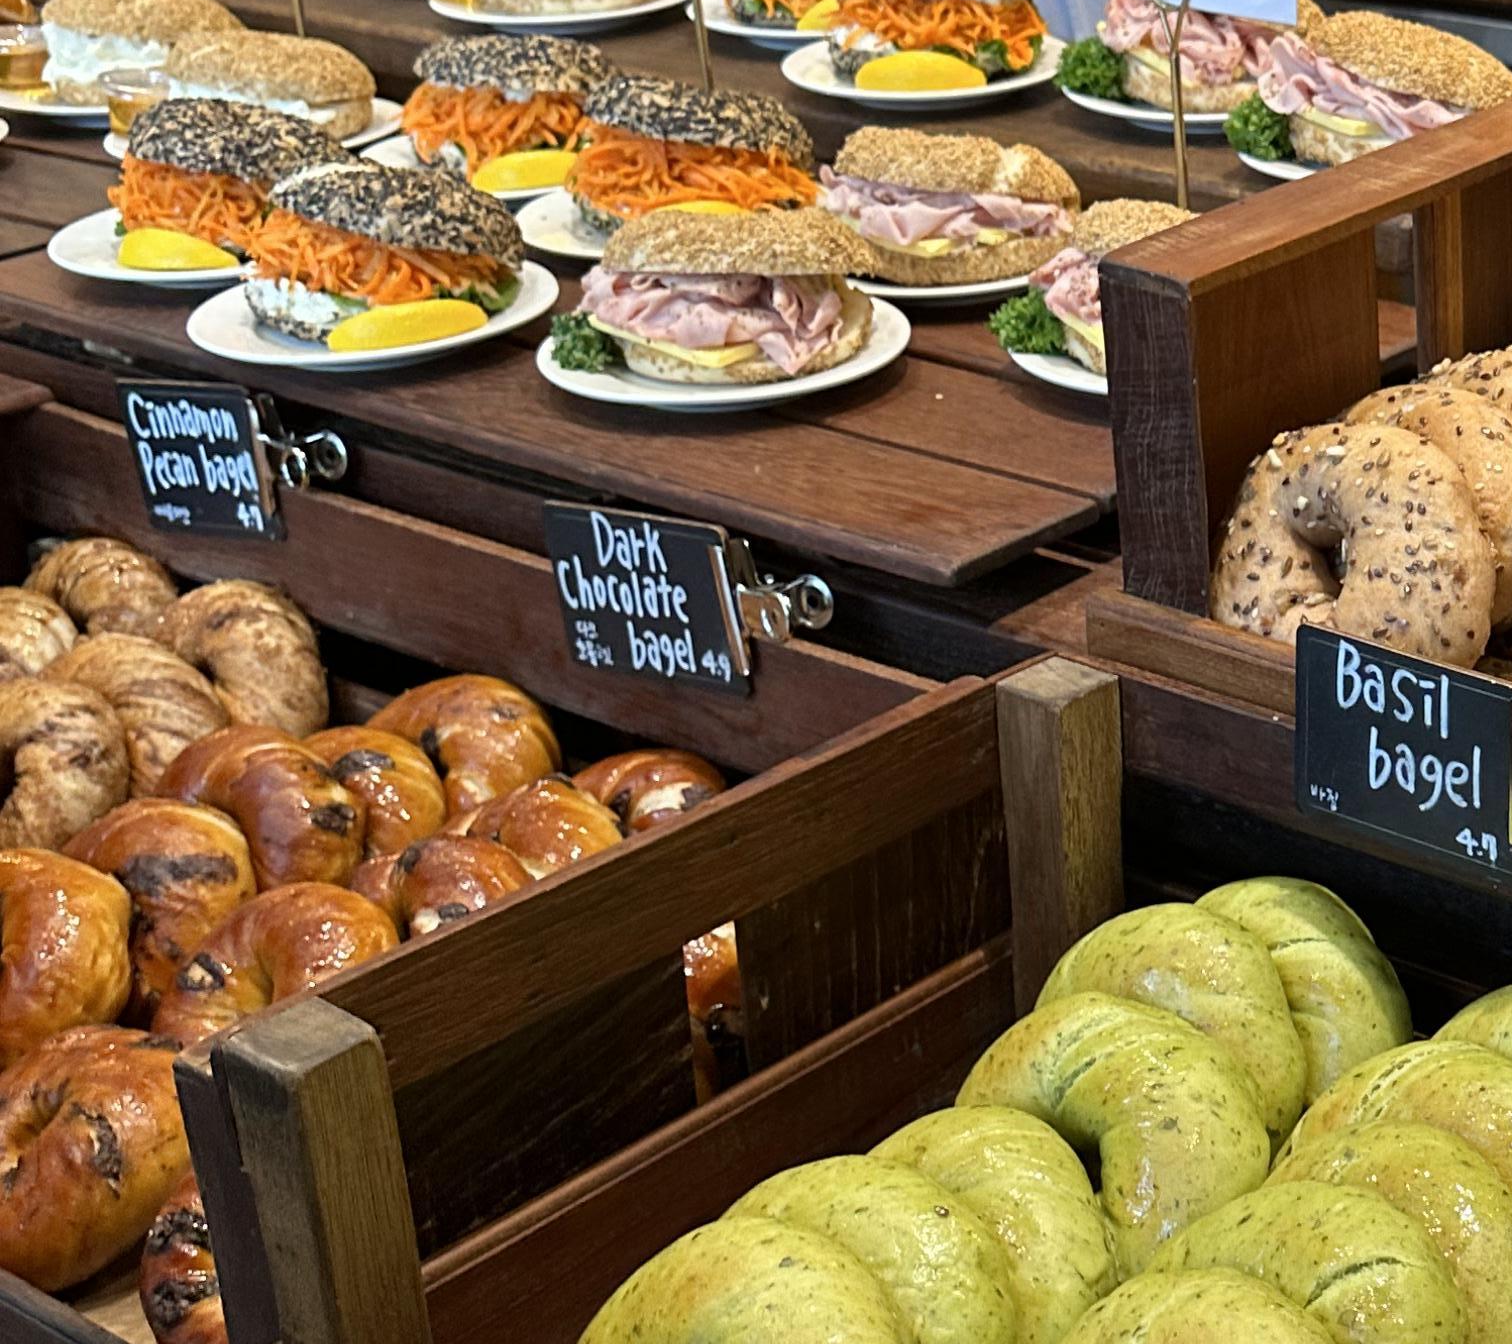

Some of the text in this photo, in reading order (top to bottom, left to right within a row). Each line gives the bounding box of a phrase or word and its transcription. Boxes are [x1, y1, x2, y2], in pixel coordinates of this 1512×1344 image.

[127, 391, 240, 445] Cinnamon
[137, 440, 260, 498] Pecan bagel
[590, 510, 668, 574] Dark
[557, 554, 690, 624] Chocolate
[625, 619, 698, 678] bagel
[1336, 638, 1450, 739] Basil
[1368, 725, 1482, 812] bagel
[1455, 827, 1499, 864] 4.7
